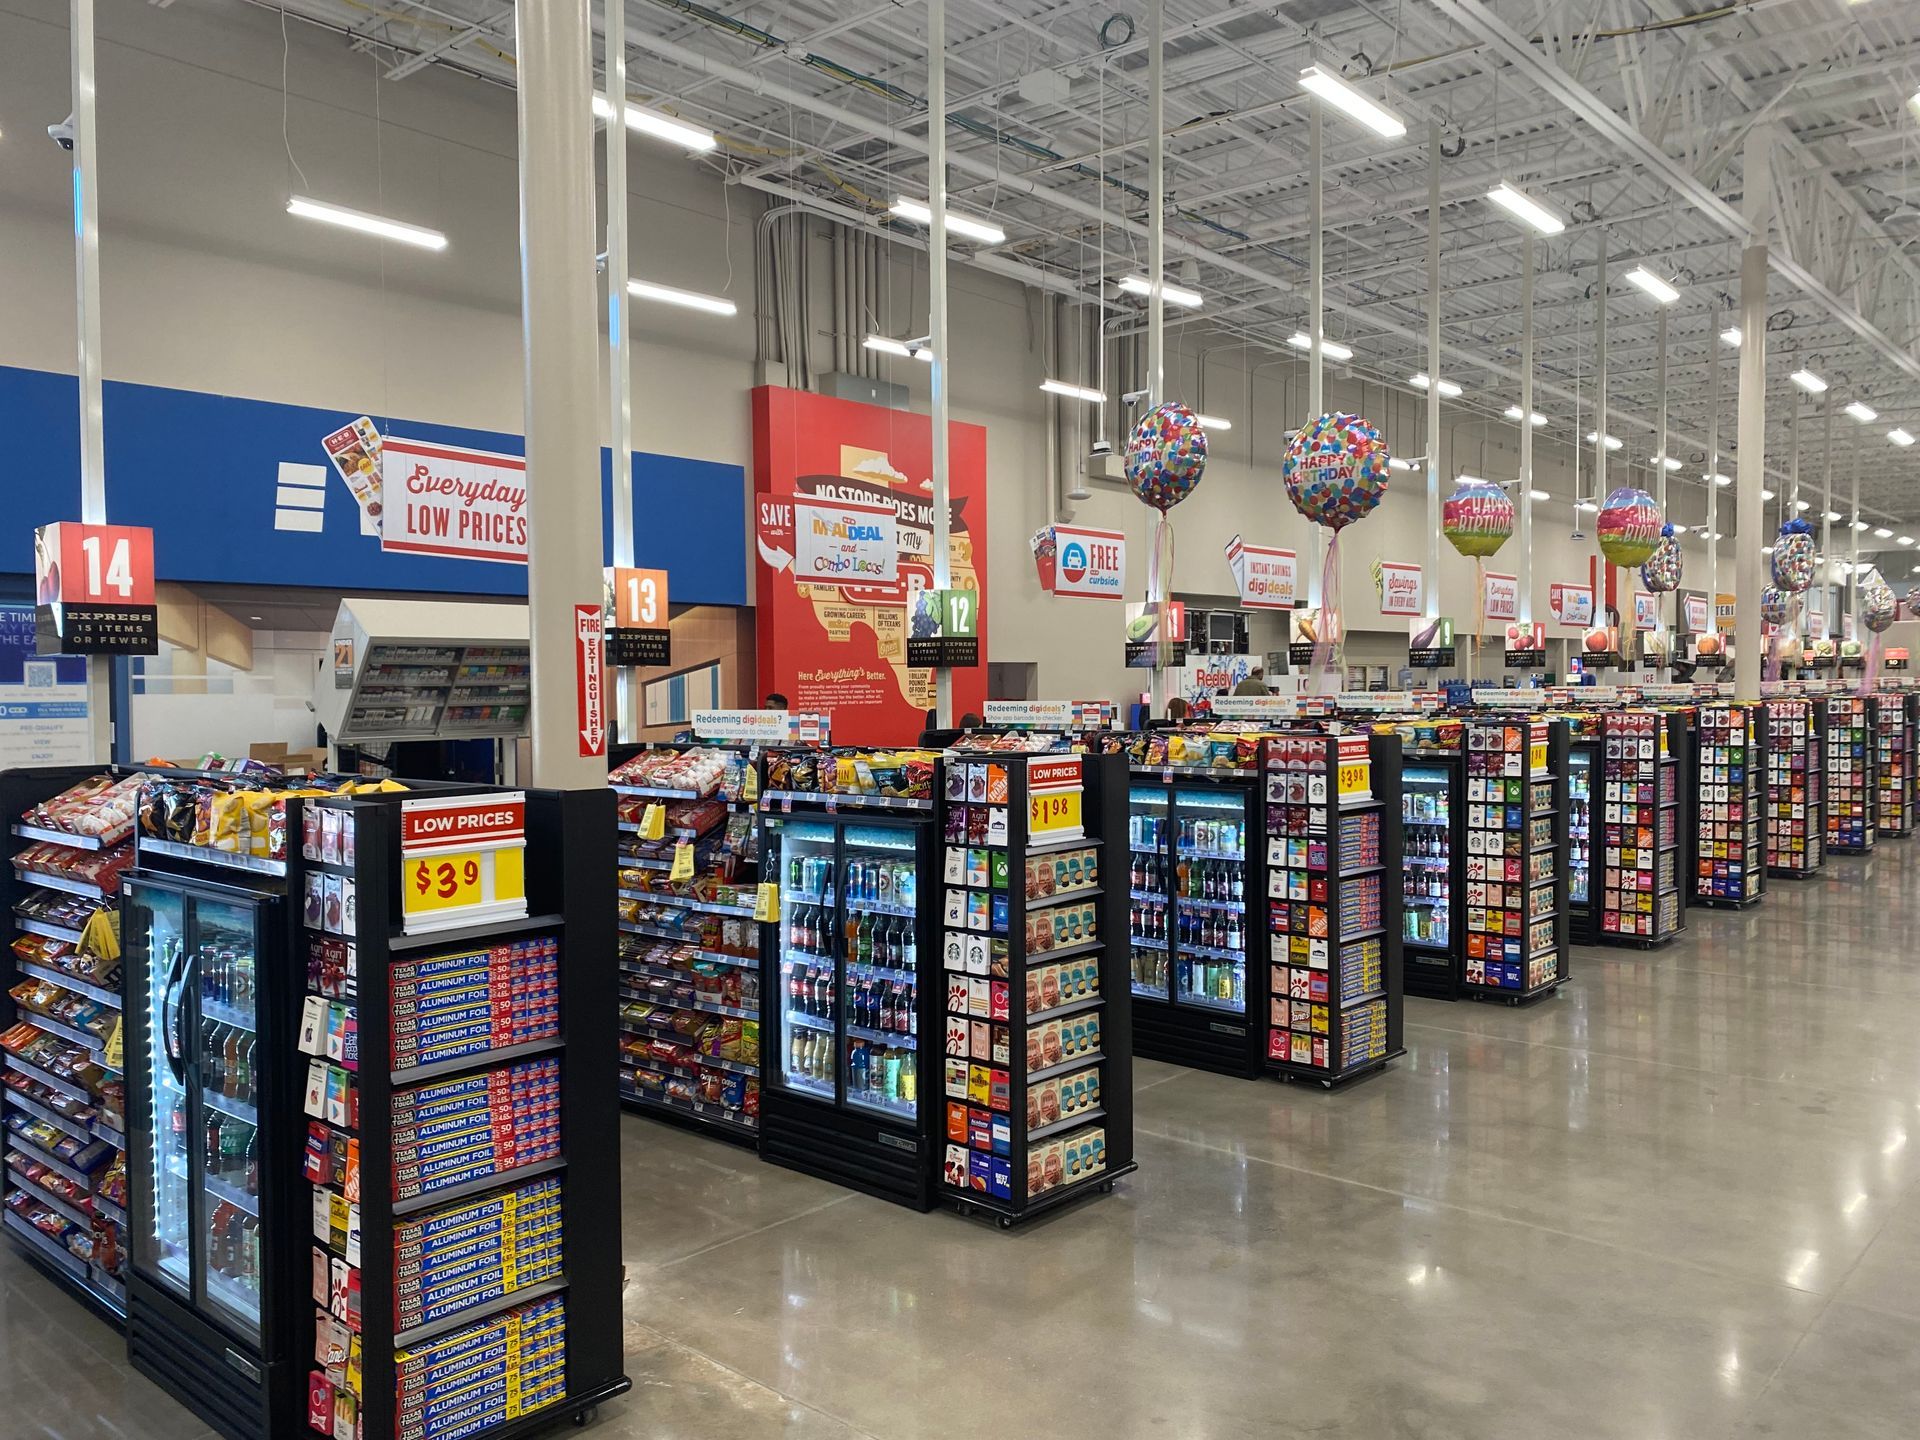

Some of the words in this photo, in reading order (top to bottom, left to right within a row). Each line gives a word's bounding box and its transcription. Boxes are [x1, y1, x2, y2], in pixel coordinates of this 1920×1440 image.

[1128, 437, 1159, 453] HAPPY
[1300, 453, 1347, 470] HAPPY
[406, 463, 527, 513] Everyday
[761, 502, 791, 527] SAVE
[918, 505, 952, 525] MOE
[407, 503, 450, 537] LOW
[459, 509, 527, 546] PRICES
[1458, 514, 1513, 534] BIRTHDA
[903, 531, 922, 550] My
[840, 543, 857, 553] and
[814, 554, 851, 572] Combo
[1090, 543, 1119, 571] FREE
[82, 536, 133, 597] 14
[1250, 562, 1271, 575] INSTANT
[1271, 564, 1291, 578] SAVINGS
[1088, 575, 1119, 586] curbside
[1388, 572, 1418, 591] Savings
[813, 584, 835, 592] FAMILIES
[1248, 579, 1293, 596] digideals
[627, 577, 656, 623] 13
[66, 611, 152, 622] EXPRESS
[824, 611, 847, 619] GROWING
[847, 611, 867, 619] CAREERS
[950, 596, 970, 633] 12
[77, 624, 91, 632] 15
[99, 624, 143, 633] ITEMS
[580, 618, 600, 633] FIRE
[884, 620, 901, 628] TEXANS
[73, 636, 92, 644] OR
[100, 636, 149, 645] FEWER
[619, 633, 668, 641] EXPRESS
[335, 645, 353, 668] 21
[798, 671, 813, 681] Here
[814, 666, 865, 683] Everything's
[866, 671, 886, 680] Better.
[588, 638, 599, 745] EXTINGUISHER
[1215, 698, 1254, 706] Redeeming
[987, 704, 1028, 714] Redeeming
[696, 714, 741, 724] Redeeming
[696, 727, 711, 735] Show
[725, 727, 748, 735] barcode
[749, 727, 756, 735] to
[757, 727, 779, 735] checker
[1338, 746, 1350, 754] LOW
[1350, 745, 1367, 753] PRICES
[1033, 769, 1052, 780] LOW
[1052, 766, 1078, 778] PRICES
[414, 816, 454, 834] LOW
[457, 811, 515, 830] PRICES
[394, 966, 415, 974] TEXAS
[420, 958, 466, 973] ALUMINUM
[468, 955, 488, 965] FOIL
[394, 972, 416, 980] TOUGH
[395, 1020, 416, 1028] TEXAS
[503, 1157, 515, 1166] 50
[424, 1172, 471, 1191] ALUMINUM
[473, 1165, 494, 1177] FOIL
[398, 1183, 420, 1193] TEXAS
[398, 1191, 421, 1200] TOUGH
[505, 1198, 515, 1207] 75
[428, 1210, 480, 1232] ALUMINUM
[481, 1202, 503, 1215] FOIL
[401, 1225, 422, 1235] TEXAS
[400, 1232, 423, 1242] TOUGH
[507, 1320, 517, 1329] 75
[435, 1337, 481, 1360] ALUMINUM
[483, 1329, 503, 1341] FOIL
[403, 1357, 425, 1367] TEXAS
[403, 1364, 425, 1374] TOUGH
